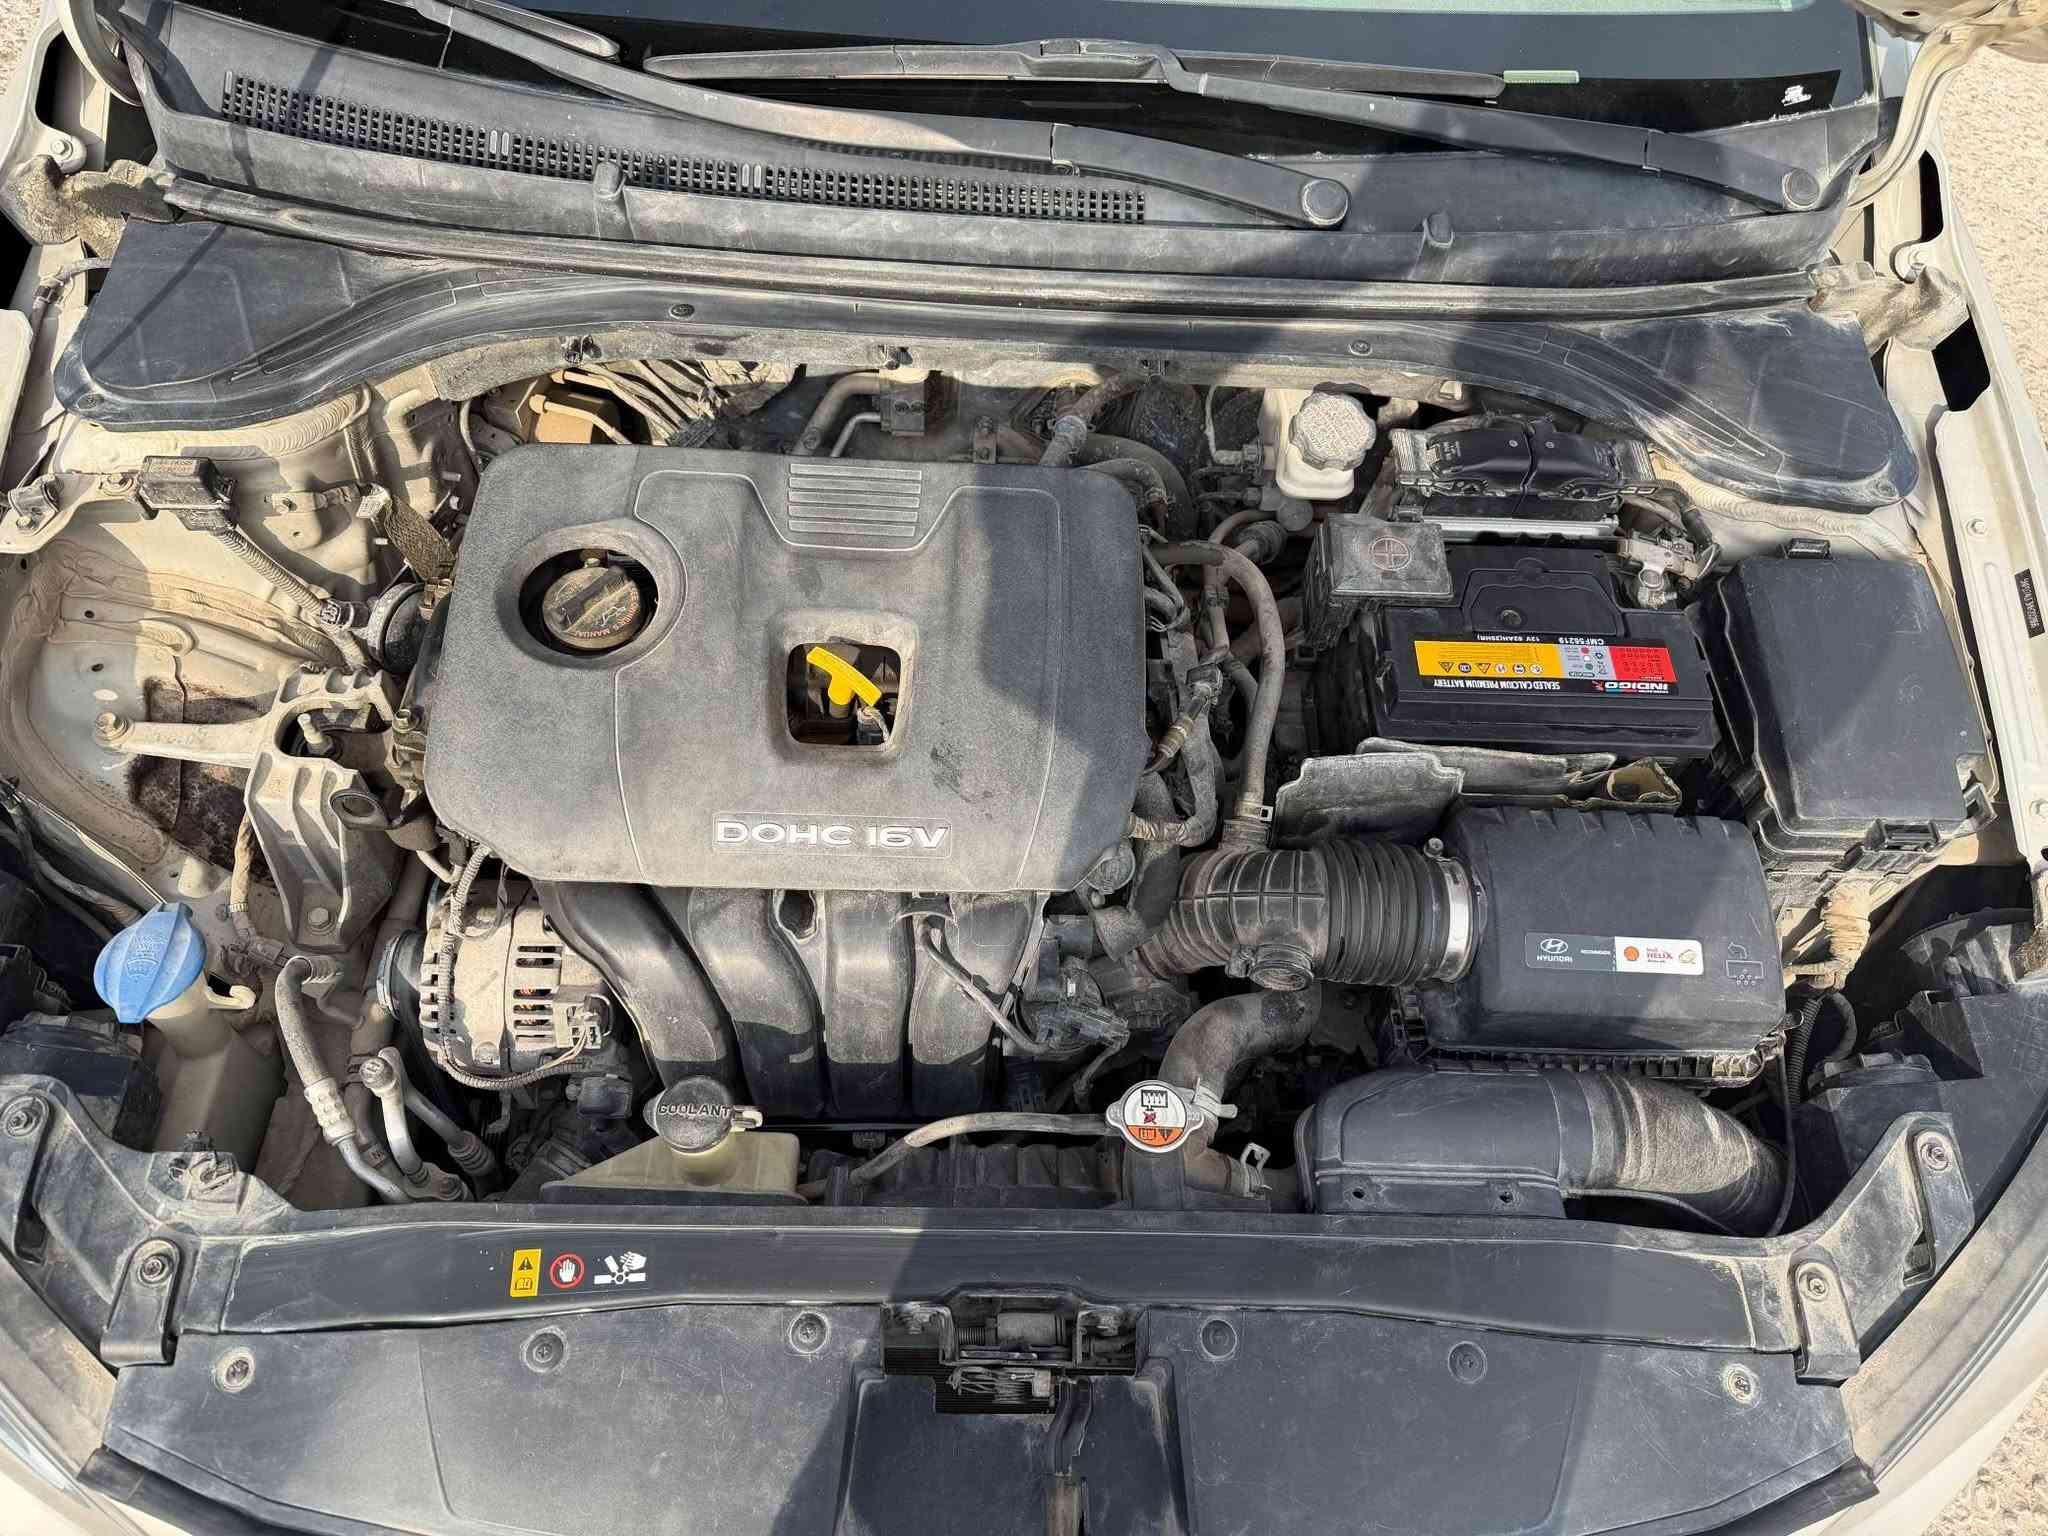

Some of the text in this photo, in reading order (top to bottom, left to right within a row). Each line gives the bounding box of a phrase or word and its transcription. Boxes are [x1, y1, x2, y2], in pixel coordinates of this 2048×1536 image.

[1433, 678, 1561, 690] SEALED CALCIUM PREMIUM BATTERY
[1605, 681, 1669, 691] INDIGO
[716, 820, 949, 849] DOHC 16V
[1536, 955, 1573, 964] HYUNDAI
[1646, 951, 1673, 960] HELIX
[658, 1103, 731, 1119] COOLANT
